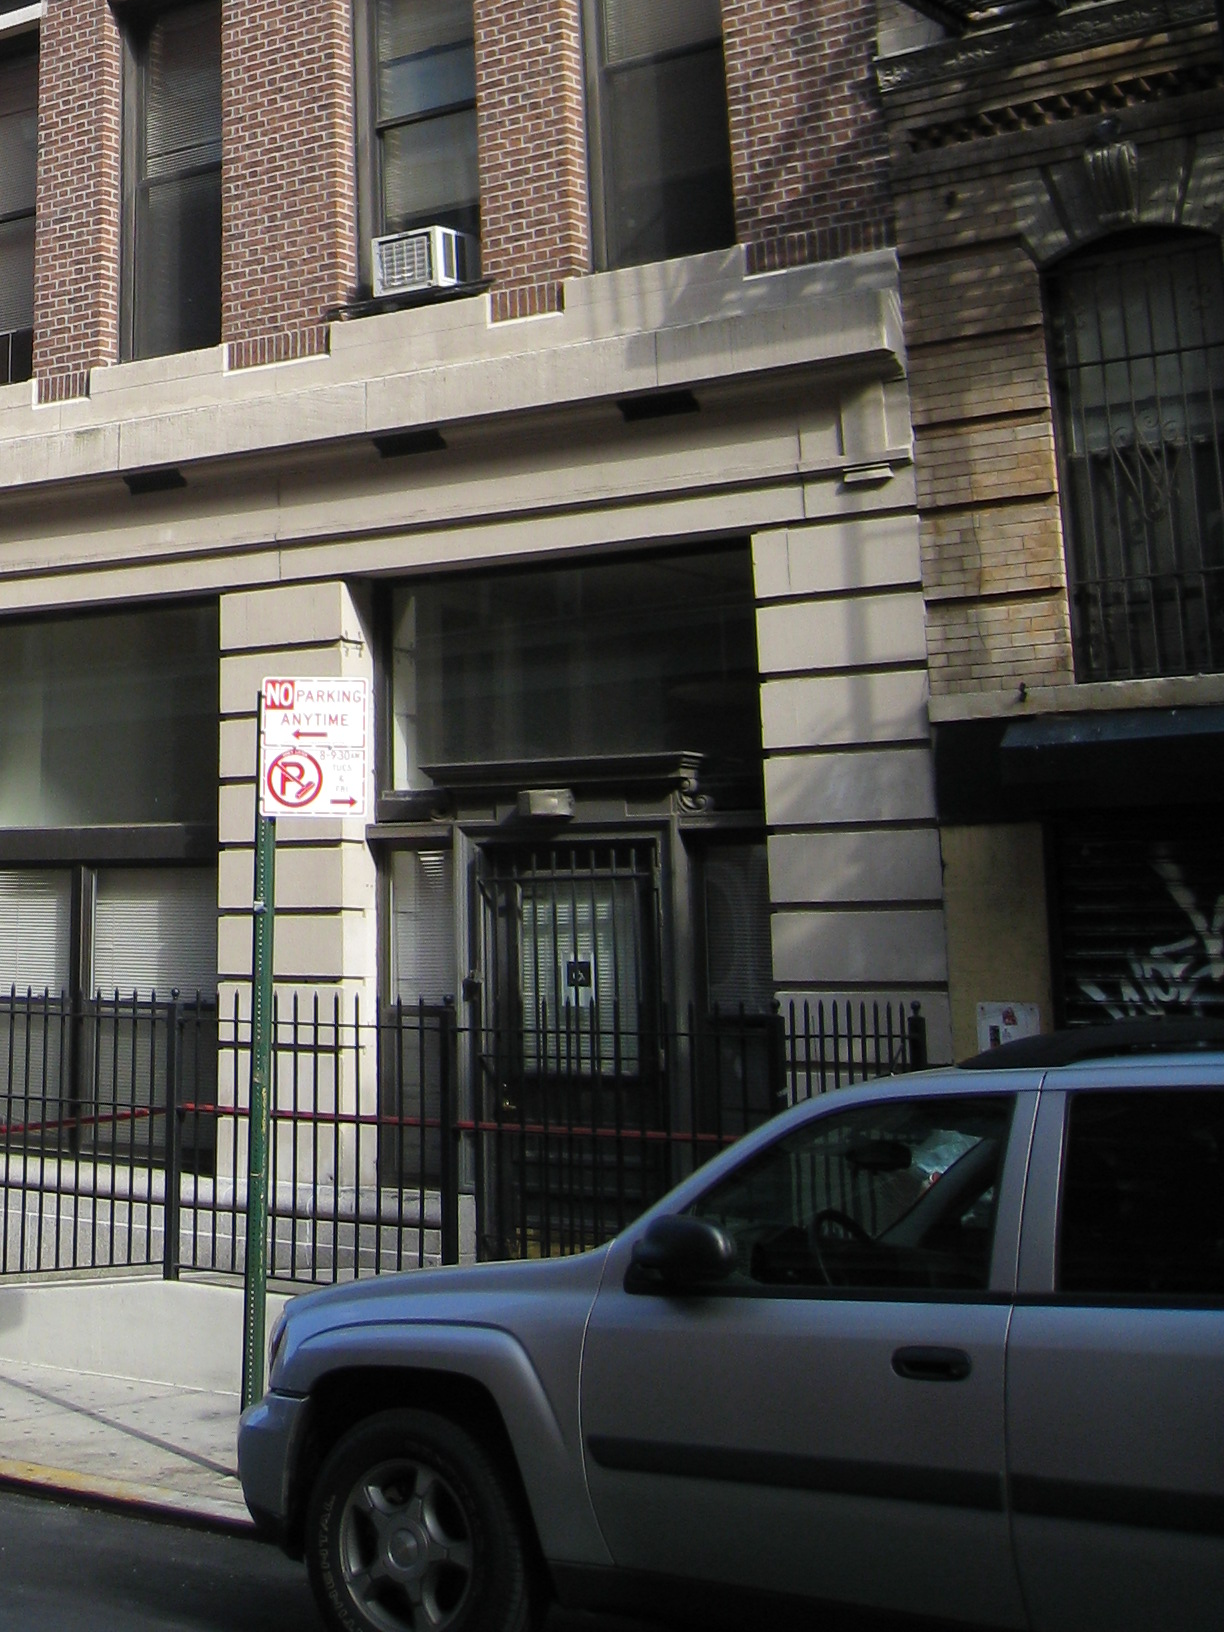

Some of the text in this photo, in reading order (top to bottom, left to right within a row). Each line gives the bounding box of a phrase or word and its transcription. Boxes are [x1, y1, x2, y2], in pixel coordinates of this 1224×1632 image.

[266, 681, 362, 707] NO PARKING
[281, 712, 349, 727] ANYTIME
